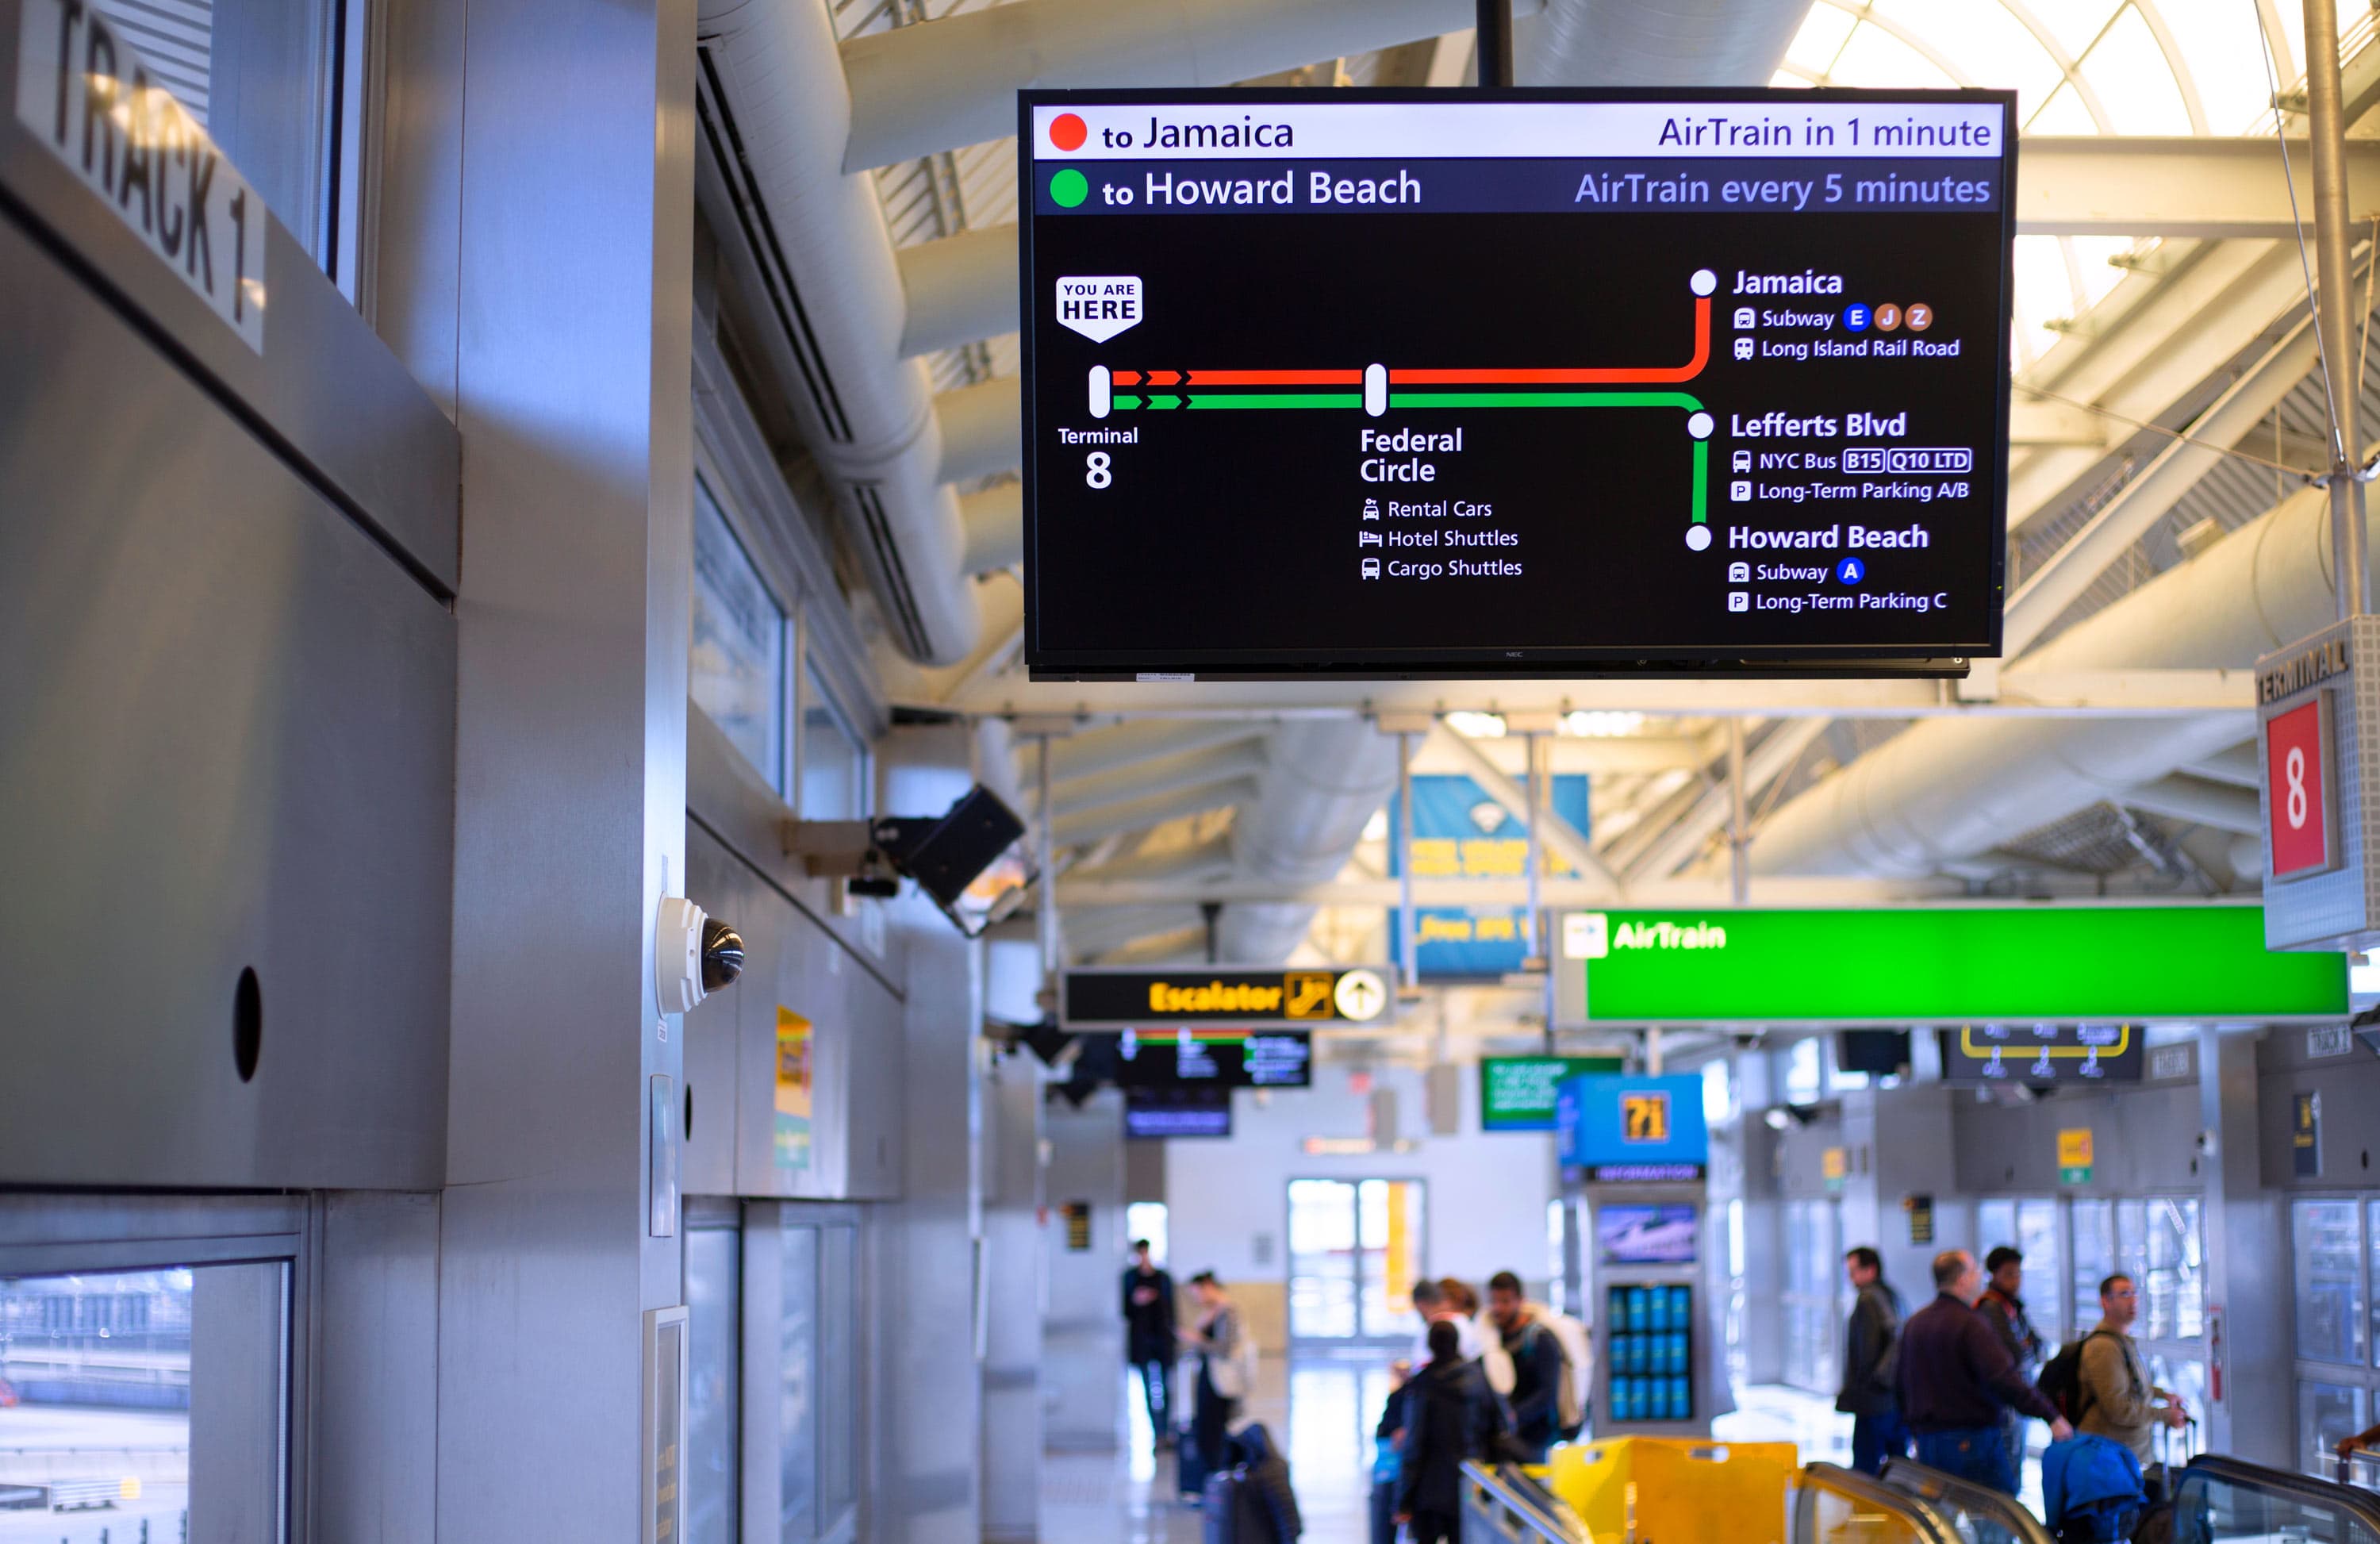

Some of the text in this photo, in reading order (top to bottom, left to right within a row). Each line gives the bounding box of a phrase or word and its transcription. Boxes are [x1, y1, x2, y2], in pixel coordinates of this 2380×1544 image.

[1102, 115, 1293, 148] to Jamaica
[1658, 117, 1990, 147] AirTrain in 1 minute
[1102, 169, 1421, 205] to Howard Beach
[1574, 172, 1990, 212] AirTrain every 5 minutes
[228, 188, 247, 325] 1
[1063, 284, 1134, 296] YOU ARE
[1732, 268, 1843, 294] Jamaica
[1063, 299, 1136, 320] HERE
[1762, 309, 1926, 331] Subway E J Z
[1762, 339, 1960, 361] Long Island Rail Road
[1058, 426, 1138, 444] Terminal
[1731, 412, 1906, 437] Lefferts Blvd
[1361, 427, 1462, 452] Federal
[1086, 451, 1112, 490] 8
[1360, 457, 1436, 482] Circle
[1760, 452, 1968, 470] NYC Bus B15 Q10 LTD
[1759, 482, 1857, 503] Long-Term
[1862, 482, 1933, 503] Parking
[1936, 482, 1970, 498] A/B
[1388, 500, 1492, 517] Rental Cars
[1388, 529, 1518, 547] Hotel Shuttles
[1729, 523, 1930, 549] Howard Beach
[1388, 559, 1522, 581] Cargo Shuttles
[1756, 563, 1859, 584] Subway A
[1756, 593, 1854, 613] Long-Term
[1859, 592, 1930, 613] Parking
[1933, 592, 1947, 609] C
[2255, 639, 2349, 705] TERMINAL
[2286, 746, 2307, 830] 8
[1613, 921, 1727, 949] AirTrain
[1149, 981, 1283, 1012] Escalator
